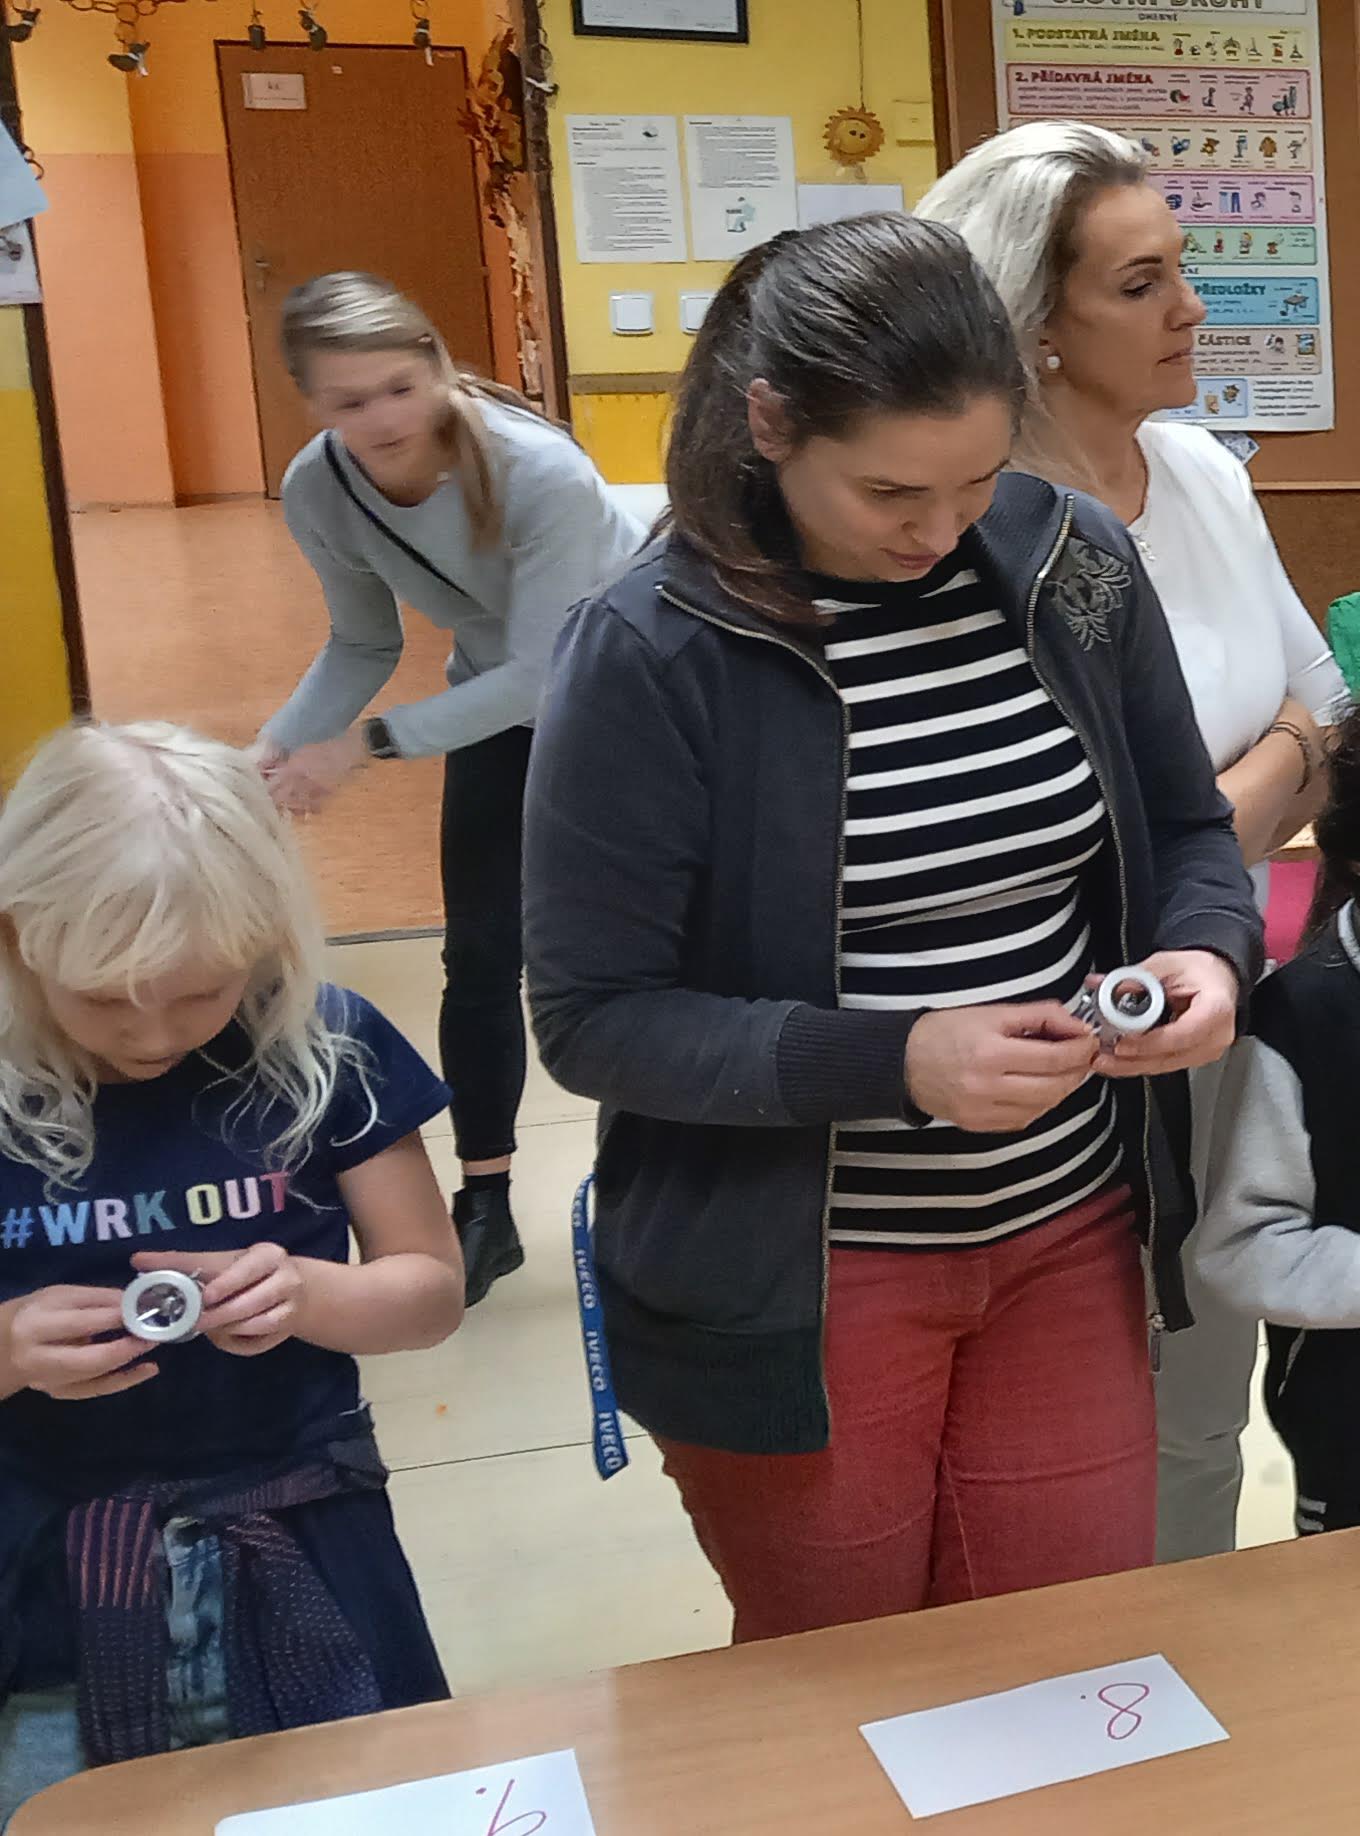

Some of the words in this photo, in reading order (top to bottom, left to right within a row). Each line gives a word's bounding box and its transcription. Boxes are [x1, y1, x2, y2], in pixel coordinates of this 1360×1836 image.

[1015, 71, 1029, 83] 2.
[1032, 70, 1103, 84] PŘÍDAVNÁ
[1106, 72, 1153, 84] JMÉNA
[1194, 282, 1266, 295] PŘEDLOŽKY
[1198, 334, 1251, 346] ČÁSTICE
[185, 1171, 289, 1226] OUT
[586, 1330, 606, 1393] IVECO
[598, 1411, 625, 1470] IVECO
[1079, 1682, 1150, 1741] 8.
